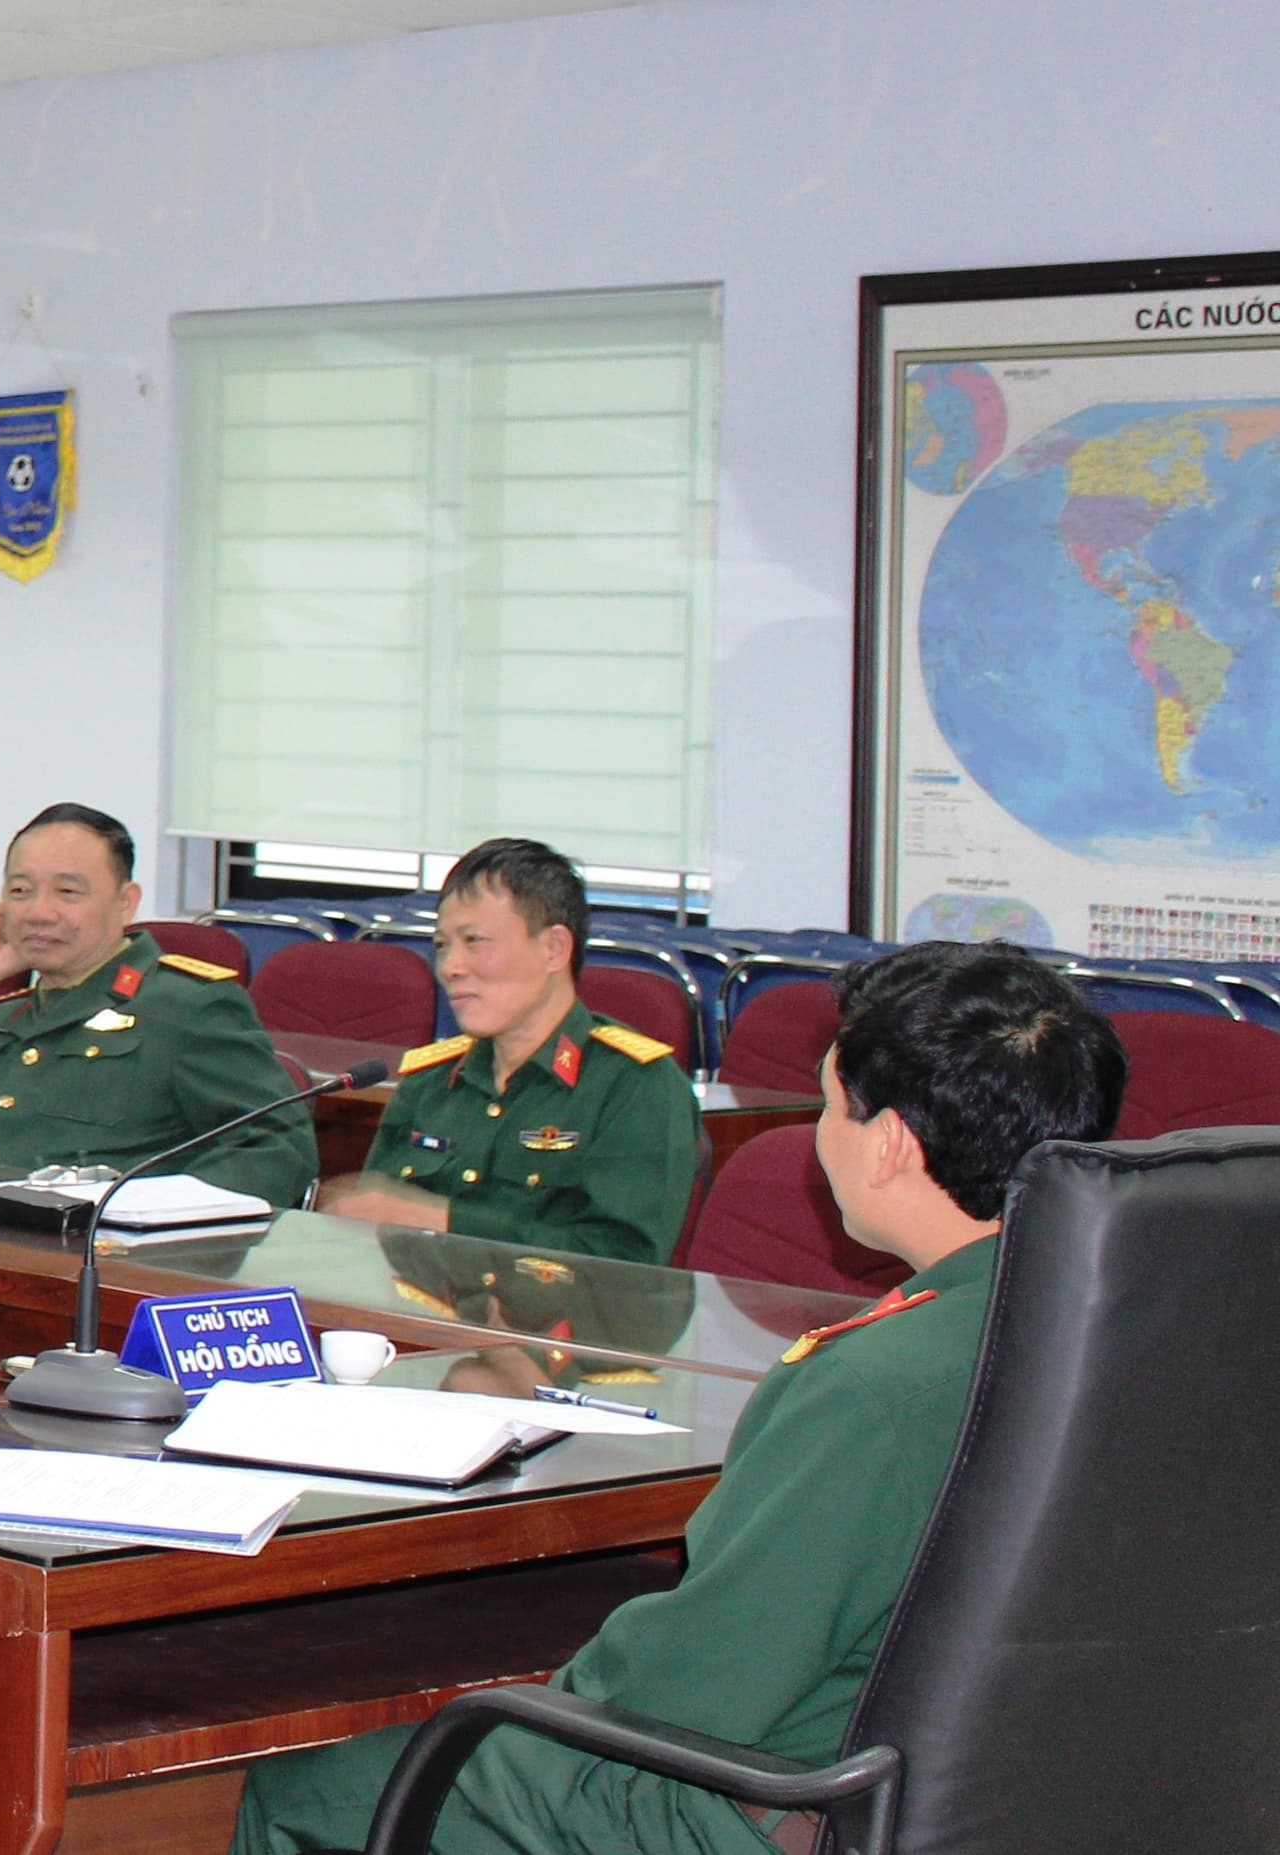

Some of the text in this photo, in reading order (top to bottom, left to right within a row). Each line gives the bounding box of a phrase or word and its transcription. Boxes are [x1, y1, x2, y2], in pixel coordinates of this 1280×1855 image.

[1136, 295, 1280, 330] CÁC NƯỚC
[185, 1305, 271, 1333] CHỦ TỊCH
[176, 1333, 303, 1379] HỘI ĐỒNG
